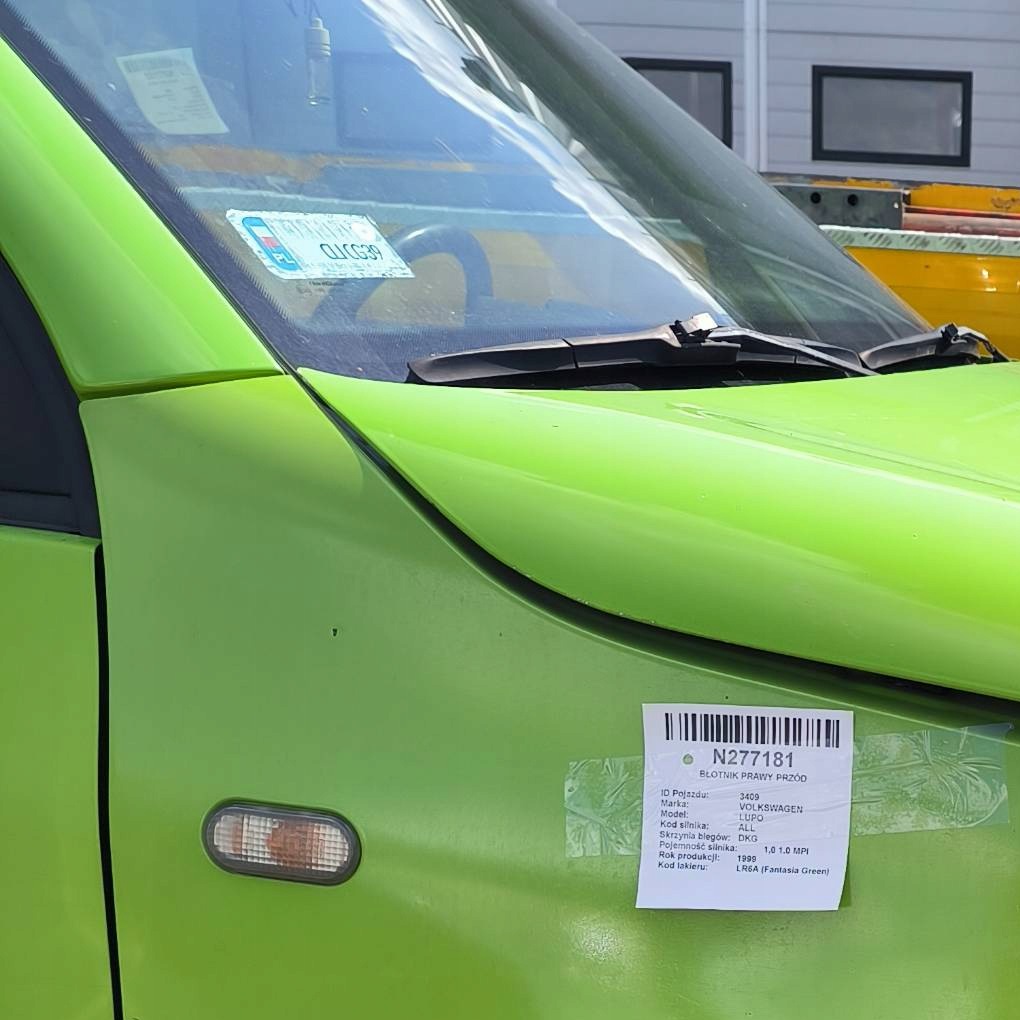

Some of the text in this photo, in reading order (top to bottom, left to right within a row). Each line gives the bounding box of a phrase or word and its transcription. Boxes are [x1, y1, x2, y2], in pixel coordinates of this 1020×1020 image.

[712, 748, 793, 768] N277181
[699, 769, 808, 783] BŁOTNIK PRAWY PRZÓD
[661, 788, 760, 801] ID Pojazdu: 3409
[660, 799, 804, 814] Marka: VOLKSWAGEN
[660, 810, 764, 822] Model: LUPO
[660, 820, 756, 832] Kod silnika: ALL
[659, 830, 759, 843] Skrzynia biegów: DKG
[659, 840, 706, 850] Pojemność
[707, 843, 738, 852] silnika:
[793, 847, 809, 855] MPI
[658, 850, 757, 863] Rok produkcji: 1999
[658, 861, 830, 876] Kod lakieru: LR6A (Fantasia Green)
